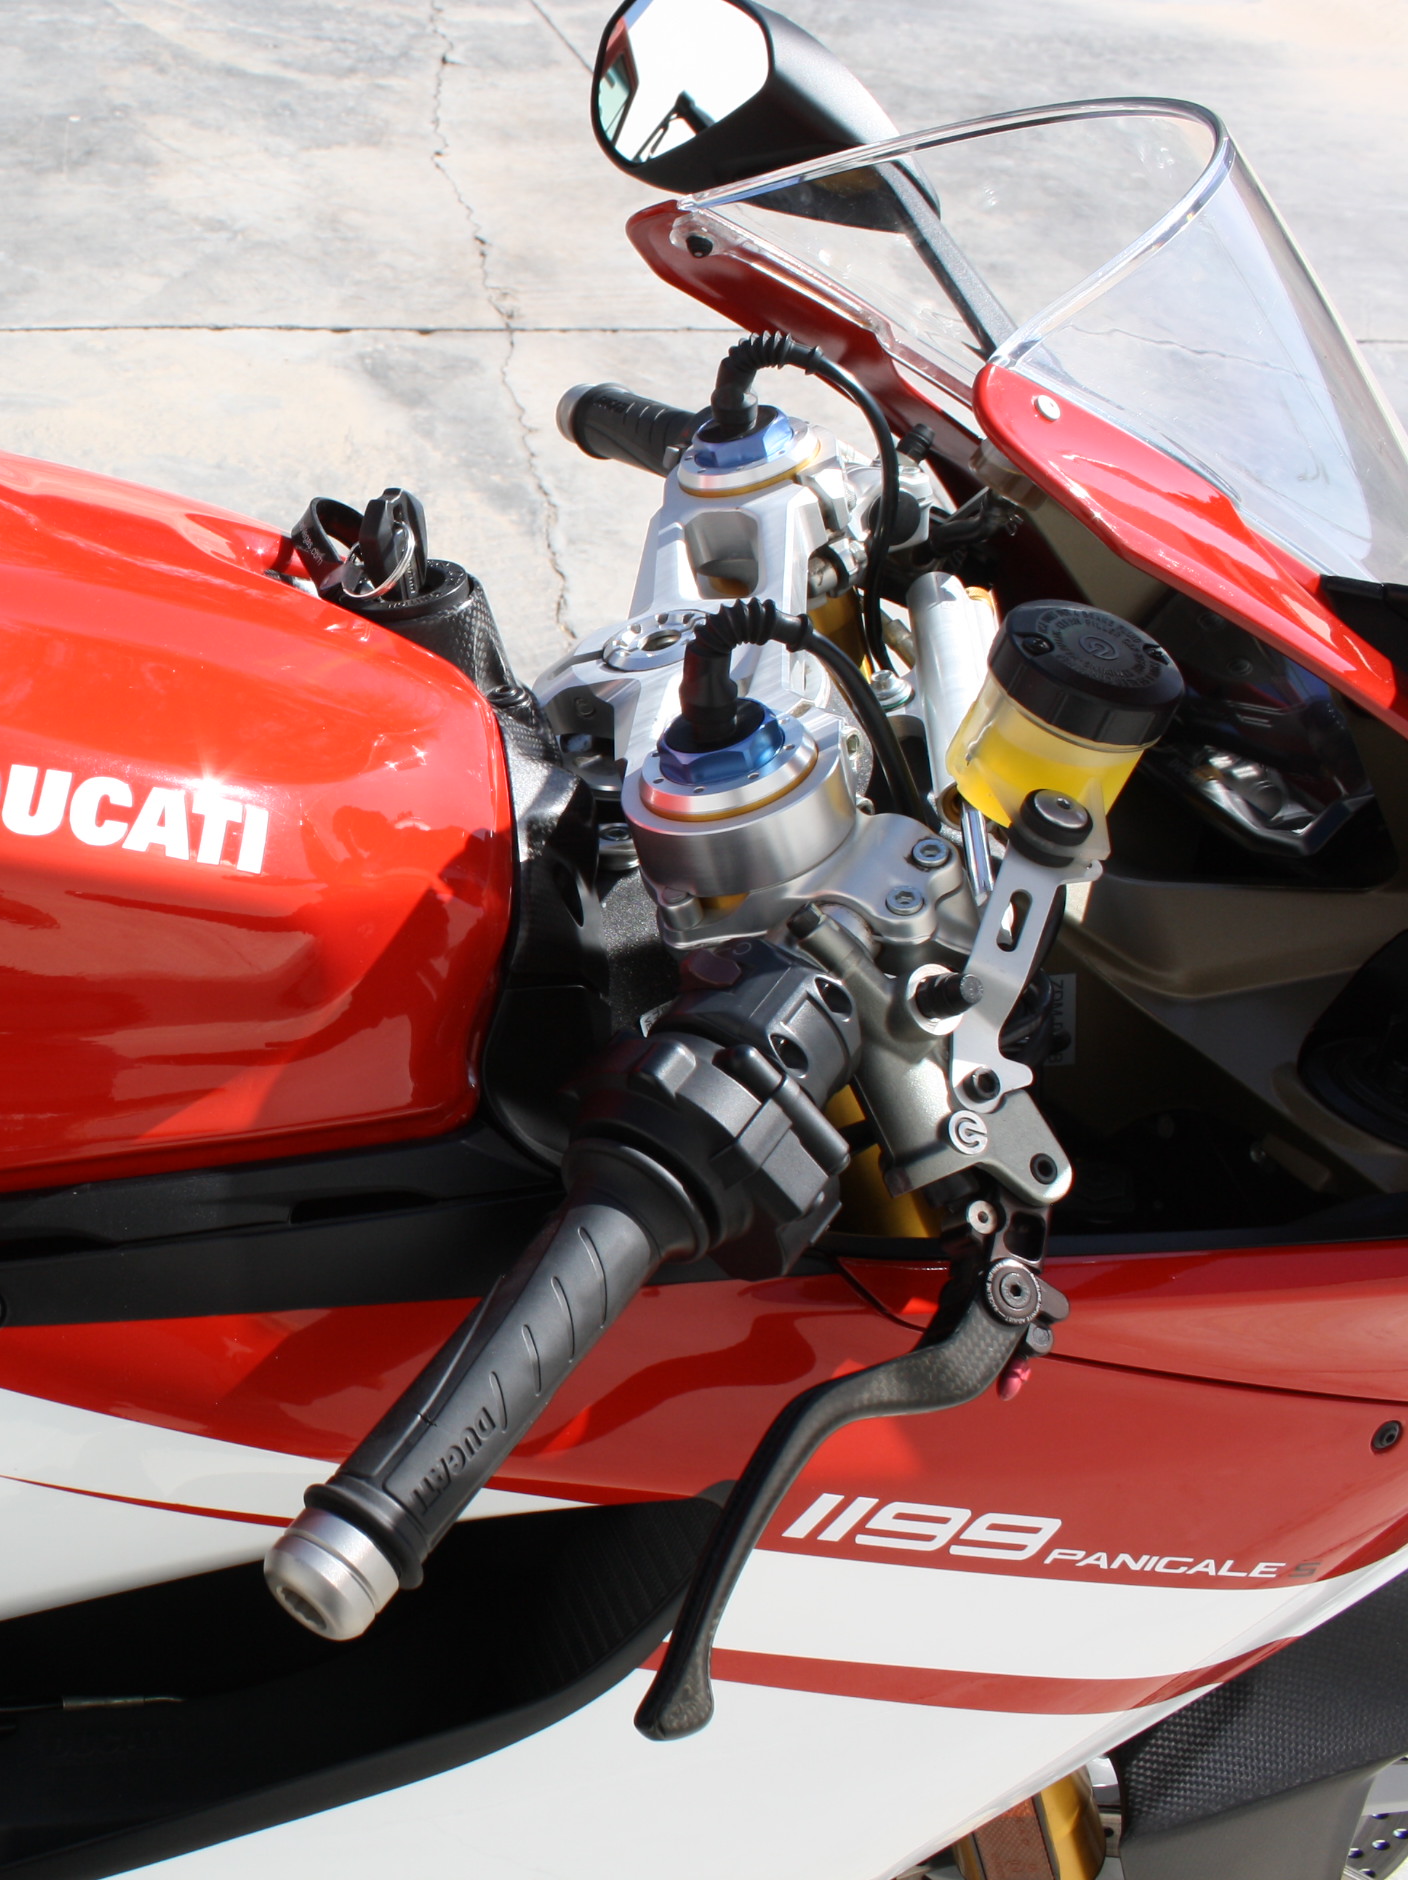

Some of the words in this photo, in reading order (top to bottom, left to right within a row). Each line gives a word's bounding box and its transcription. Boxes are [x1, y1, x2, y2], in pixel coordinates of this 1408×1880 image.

[410, 1406, 496, 1514] DUCATI
[782, 1493, 1062, 1561] 1199
[1044, 1548, 1286, 1578] PANIGALE
